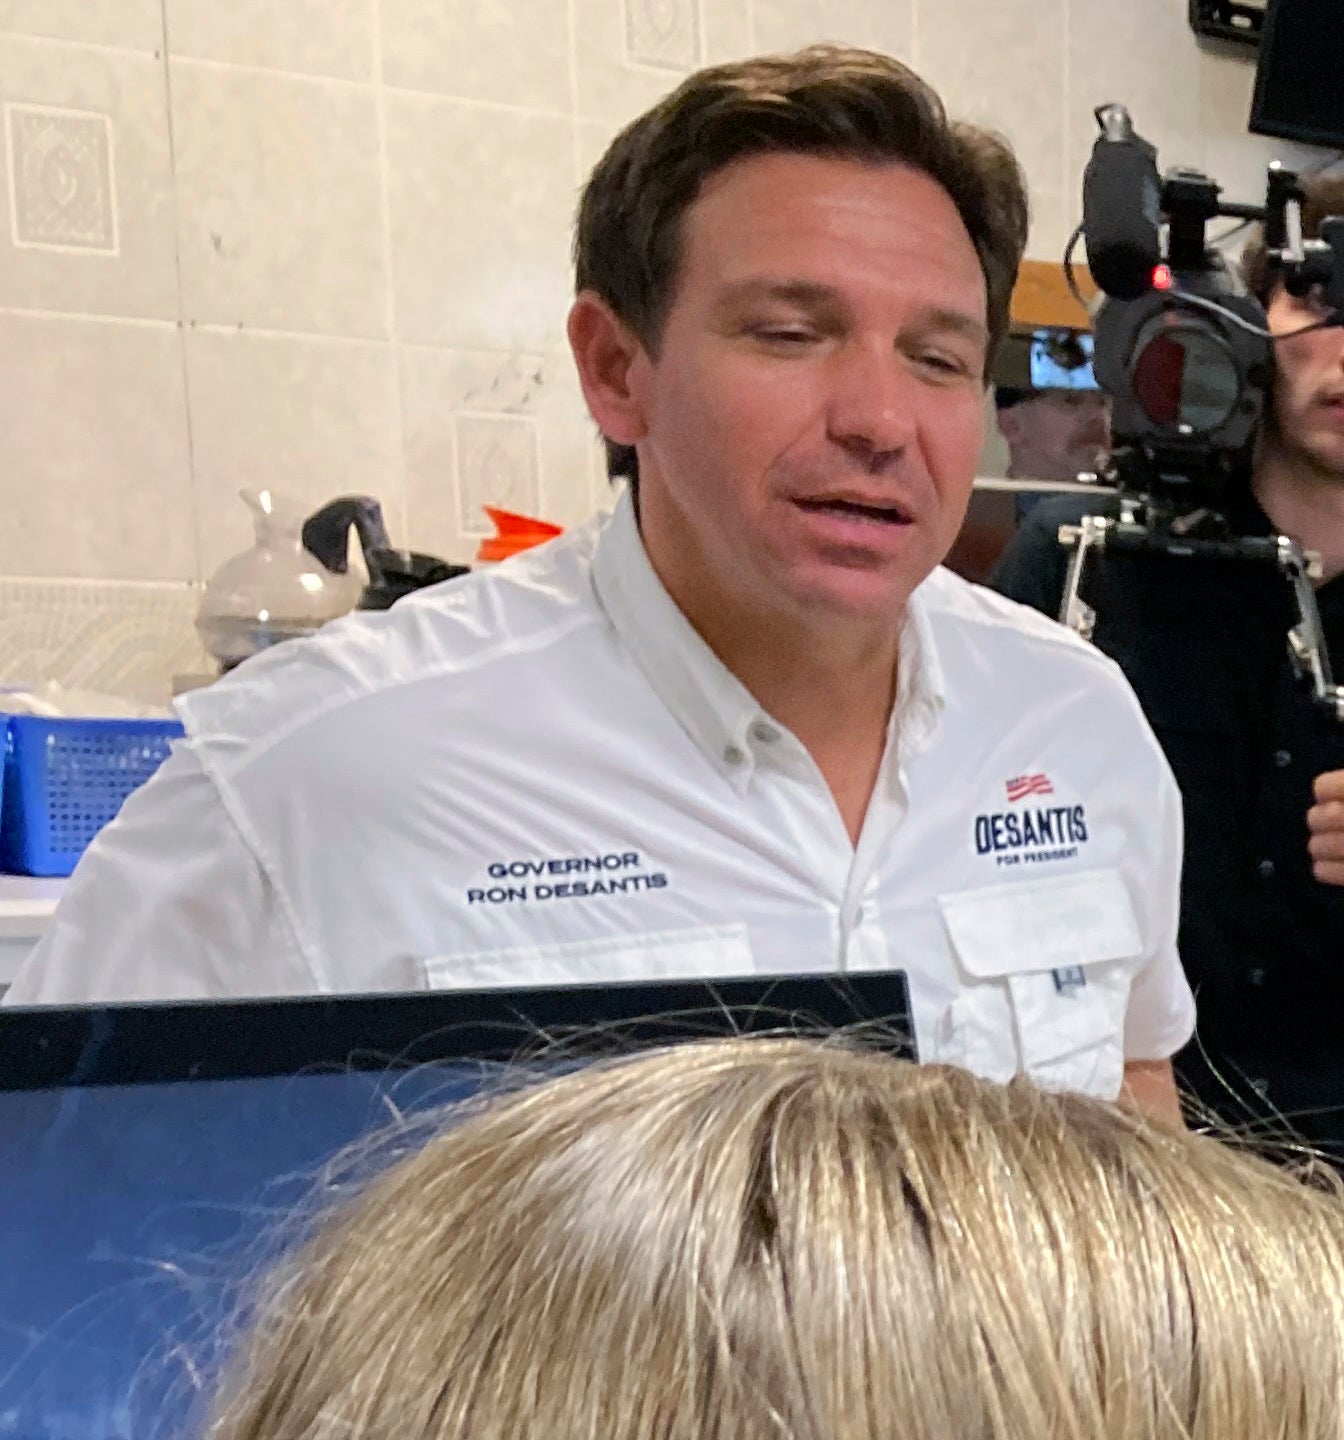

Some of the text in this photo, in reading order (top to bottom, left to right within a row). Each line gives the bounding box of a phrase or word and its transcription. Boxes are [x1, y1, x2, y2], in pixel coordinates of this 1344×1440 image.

[975, 804, 1088, 854] DESANTIS
[488, 852, 639, 878] GOVERNOR
[467, 873, 668, 904] RON DESANTIS
